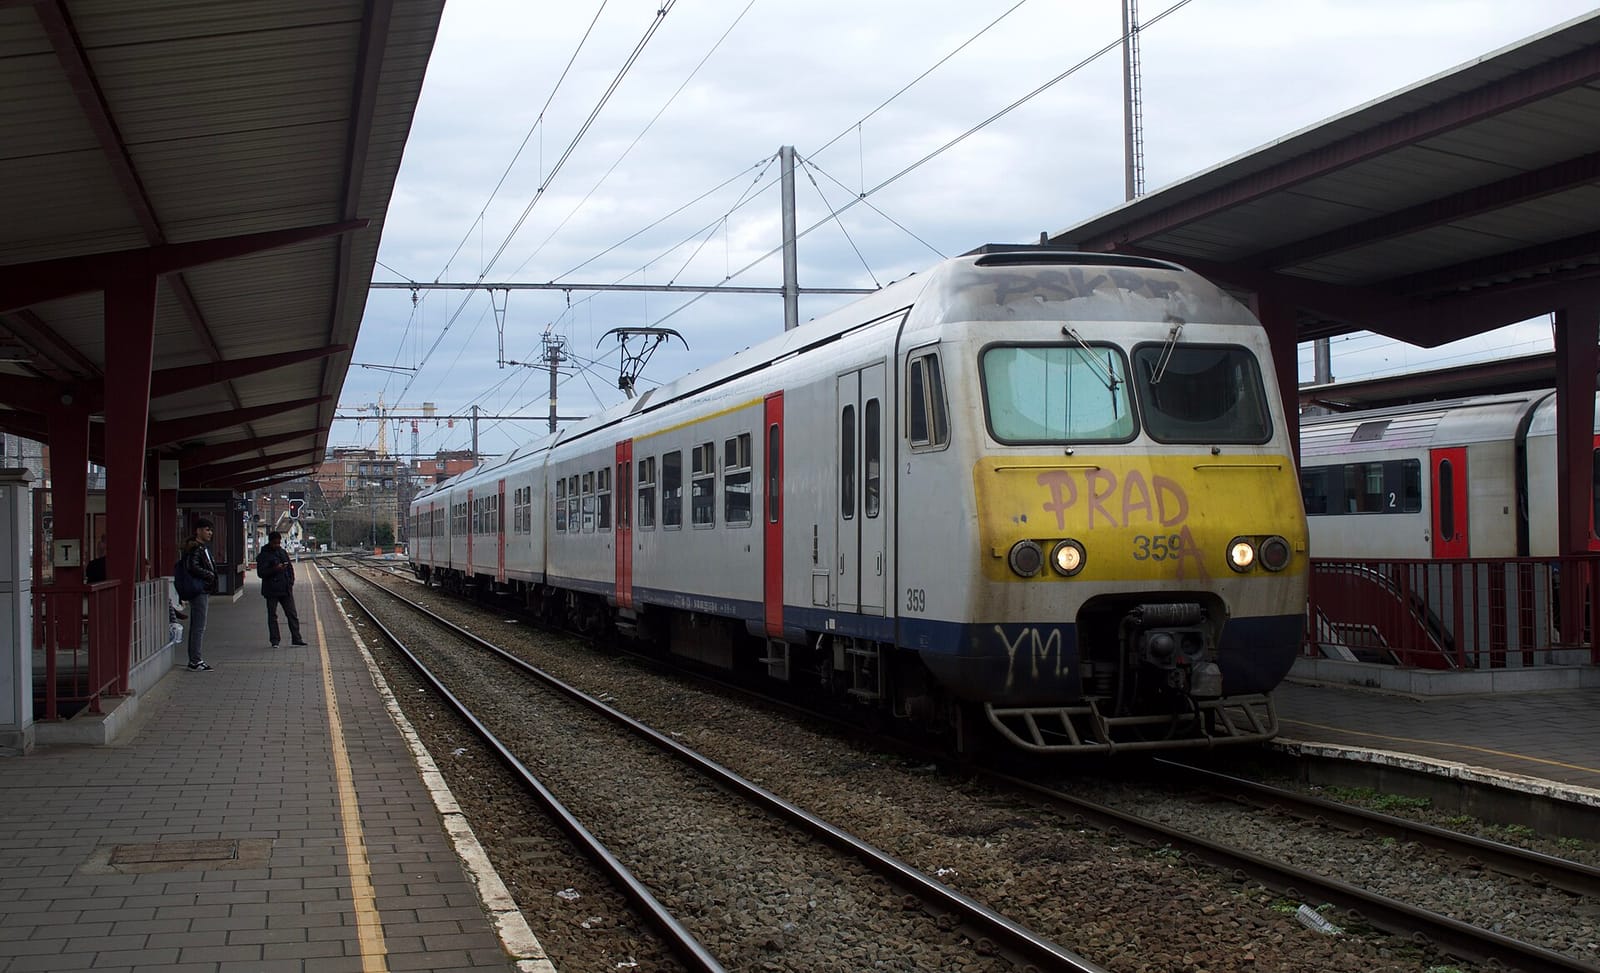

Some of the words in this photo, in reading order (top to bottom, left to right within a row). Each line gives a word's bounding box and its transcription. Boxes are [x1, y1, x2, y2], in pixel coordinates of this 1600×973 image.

[906, 462, 912, 475] 2
[1389, 492, 1396, 507] 2
[61, 545, 72, 560] T
[1133, 533, 1181, 561] 359
[906, 588, 926, 612] 359
